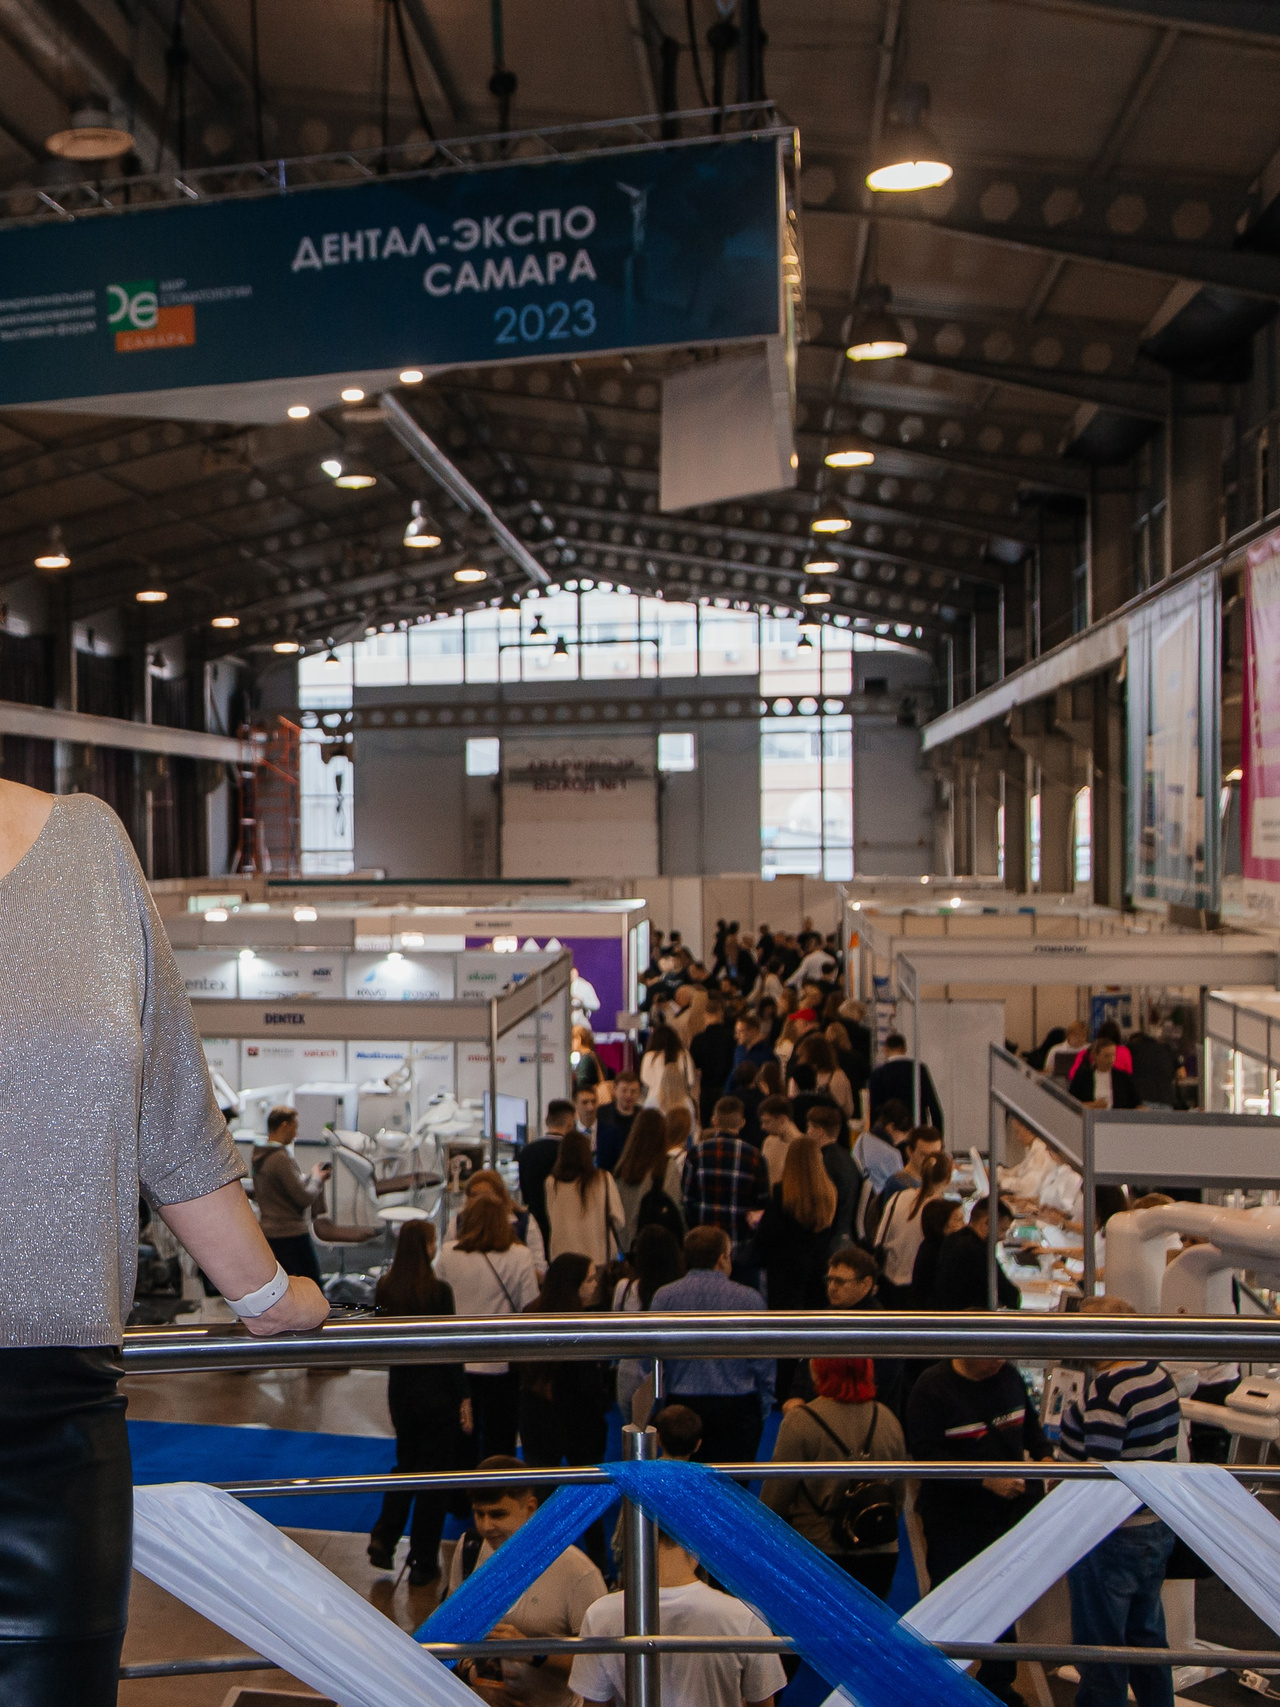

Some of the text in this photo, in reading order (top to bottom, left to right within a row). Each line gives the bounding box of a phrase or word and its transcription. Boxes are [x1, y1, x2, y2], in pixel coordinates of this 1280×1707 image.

[291, 205, 597, 272] ДЕНТАЛ-ЭКСПО
[423, 249, 597, 297] САМАРА
[493, 299, 597, 344] 2023
[185, 977, 228, 991] entex
[264, 1012, 306, 1025] DENTEX
